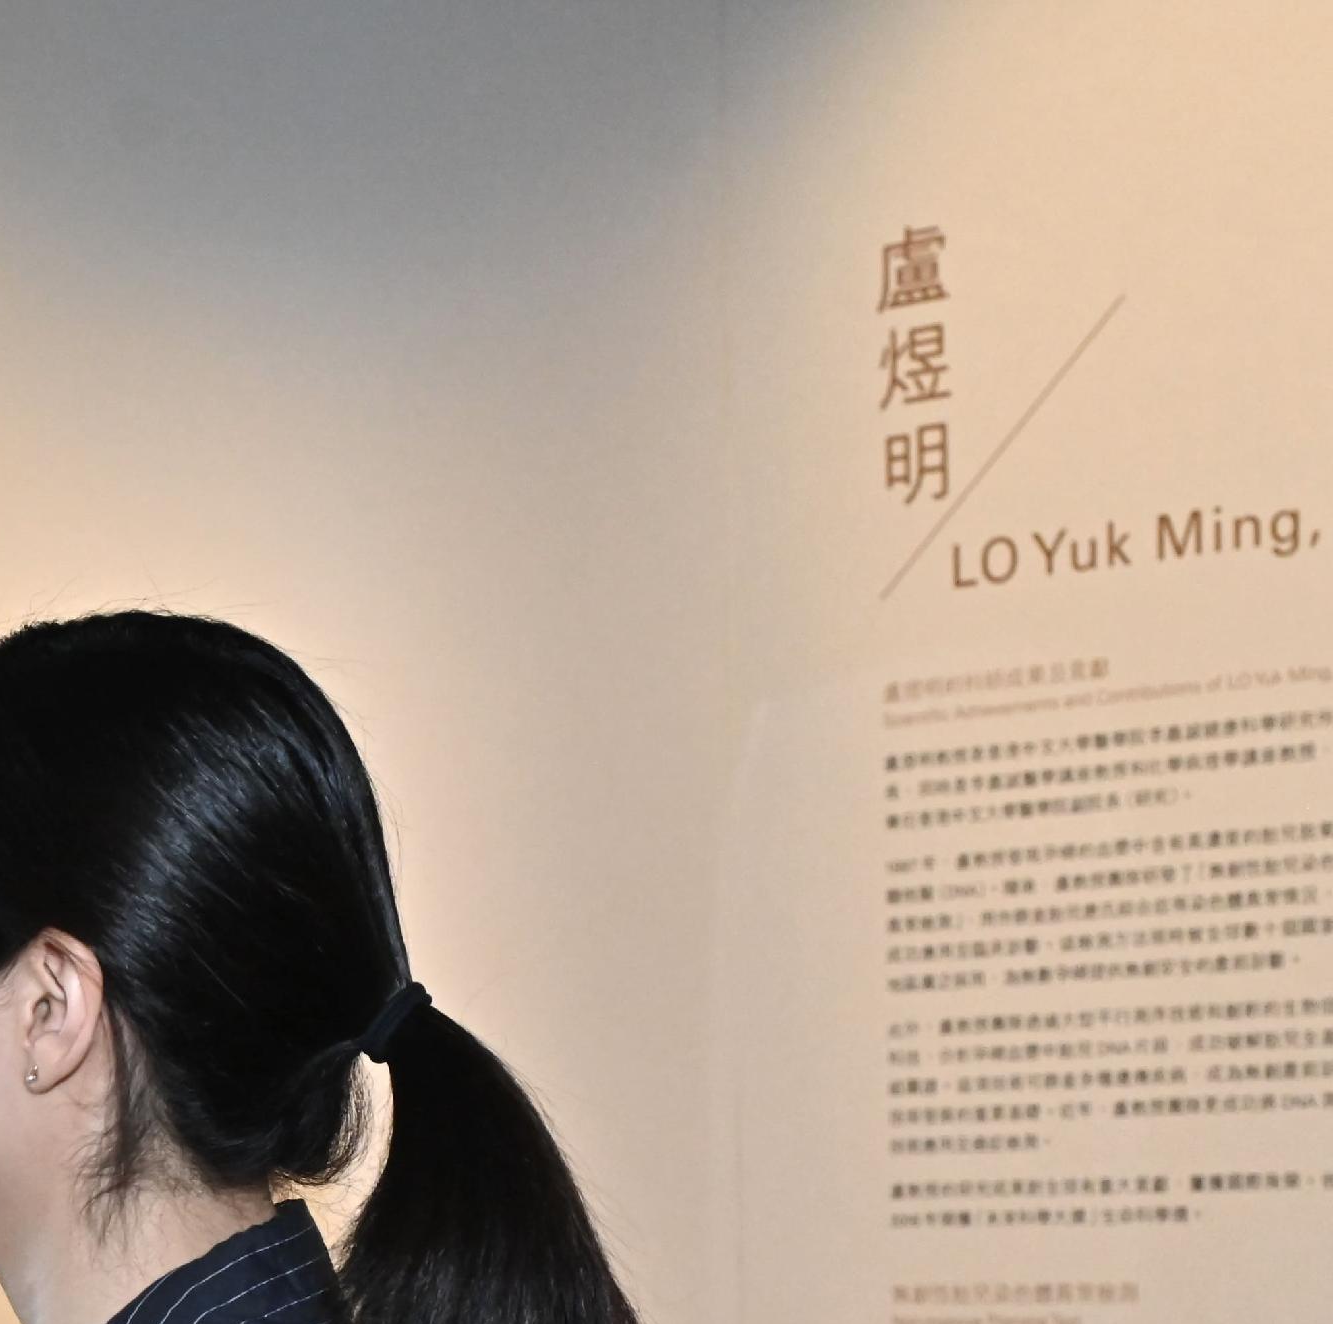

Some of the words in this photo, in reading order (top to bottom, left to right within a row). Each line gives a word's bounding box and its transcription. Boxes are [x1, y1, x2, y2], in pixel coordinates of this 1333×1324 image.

[877, 224, 951, 504] 盧煜明
[952, 535, 1017, 588] LO
[1032, 521, 1130, 576] Yuk
[1156, 506, 1321, 561] Ming,
